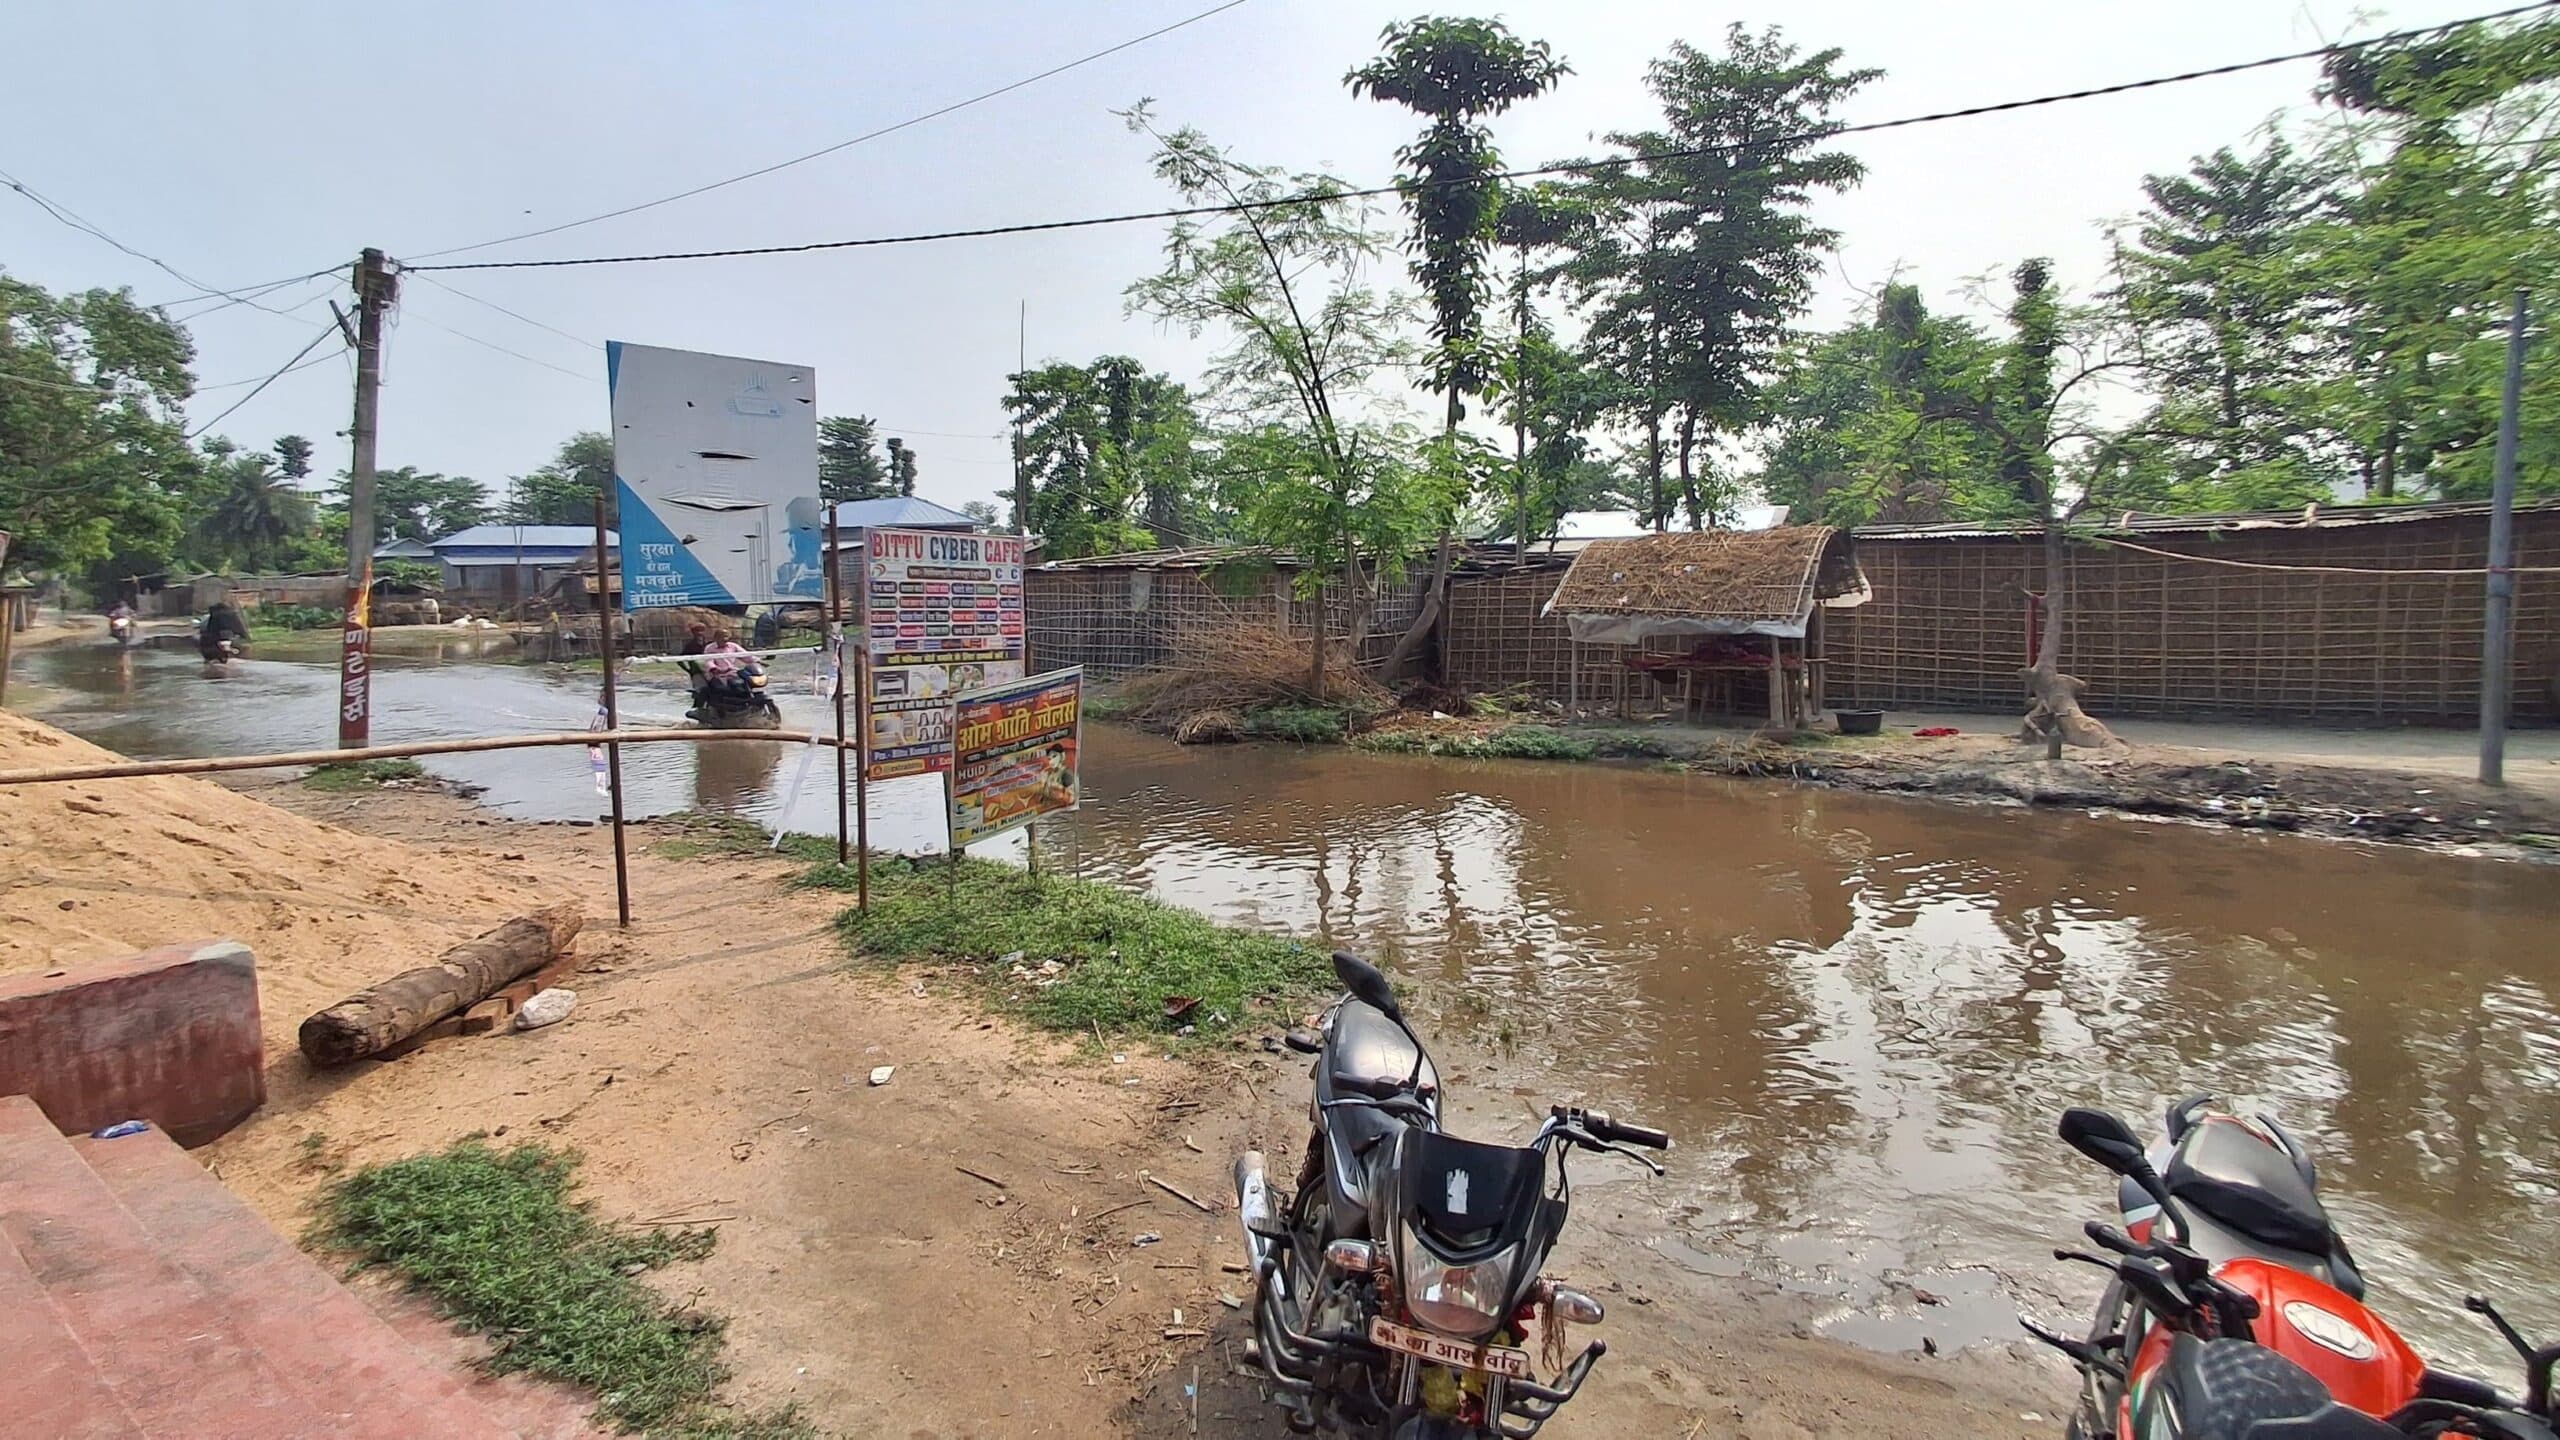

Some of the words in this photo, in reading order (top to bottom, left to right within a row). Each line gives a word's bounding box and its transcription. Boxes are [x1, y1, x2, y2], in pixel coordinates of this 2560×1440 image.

[640, 543, 675, 560] सुरक्षा
[872, 533, 924, 559] BITTU
[929, 536, 979, 561] CYBER
[984, 540, 1020, 563] CAFE
[635, 571, 683, 590] मजबूती
[958, 720, 993, 751] ओम
[958, 764, 986, 780] HUID
[971, 821, 998, 835] Niraj
[1000, 810, 1033, 826] Kumar
